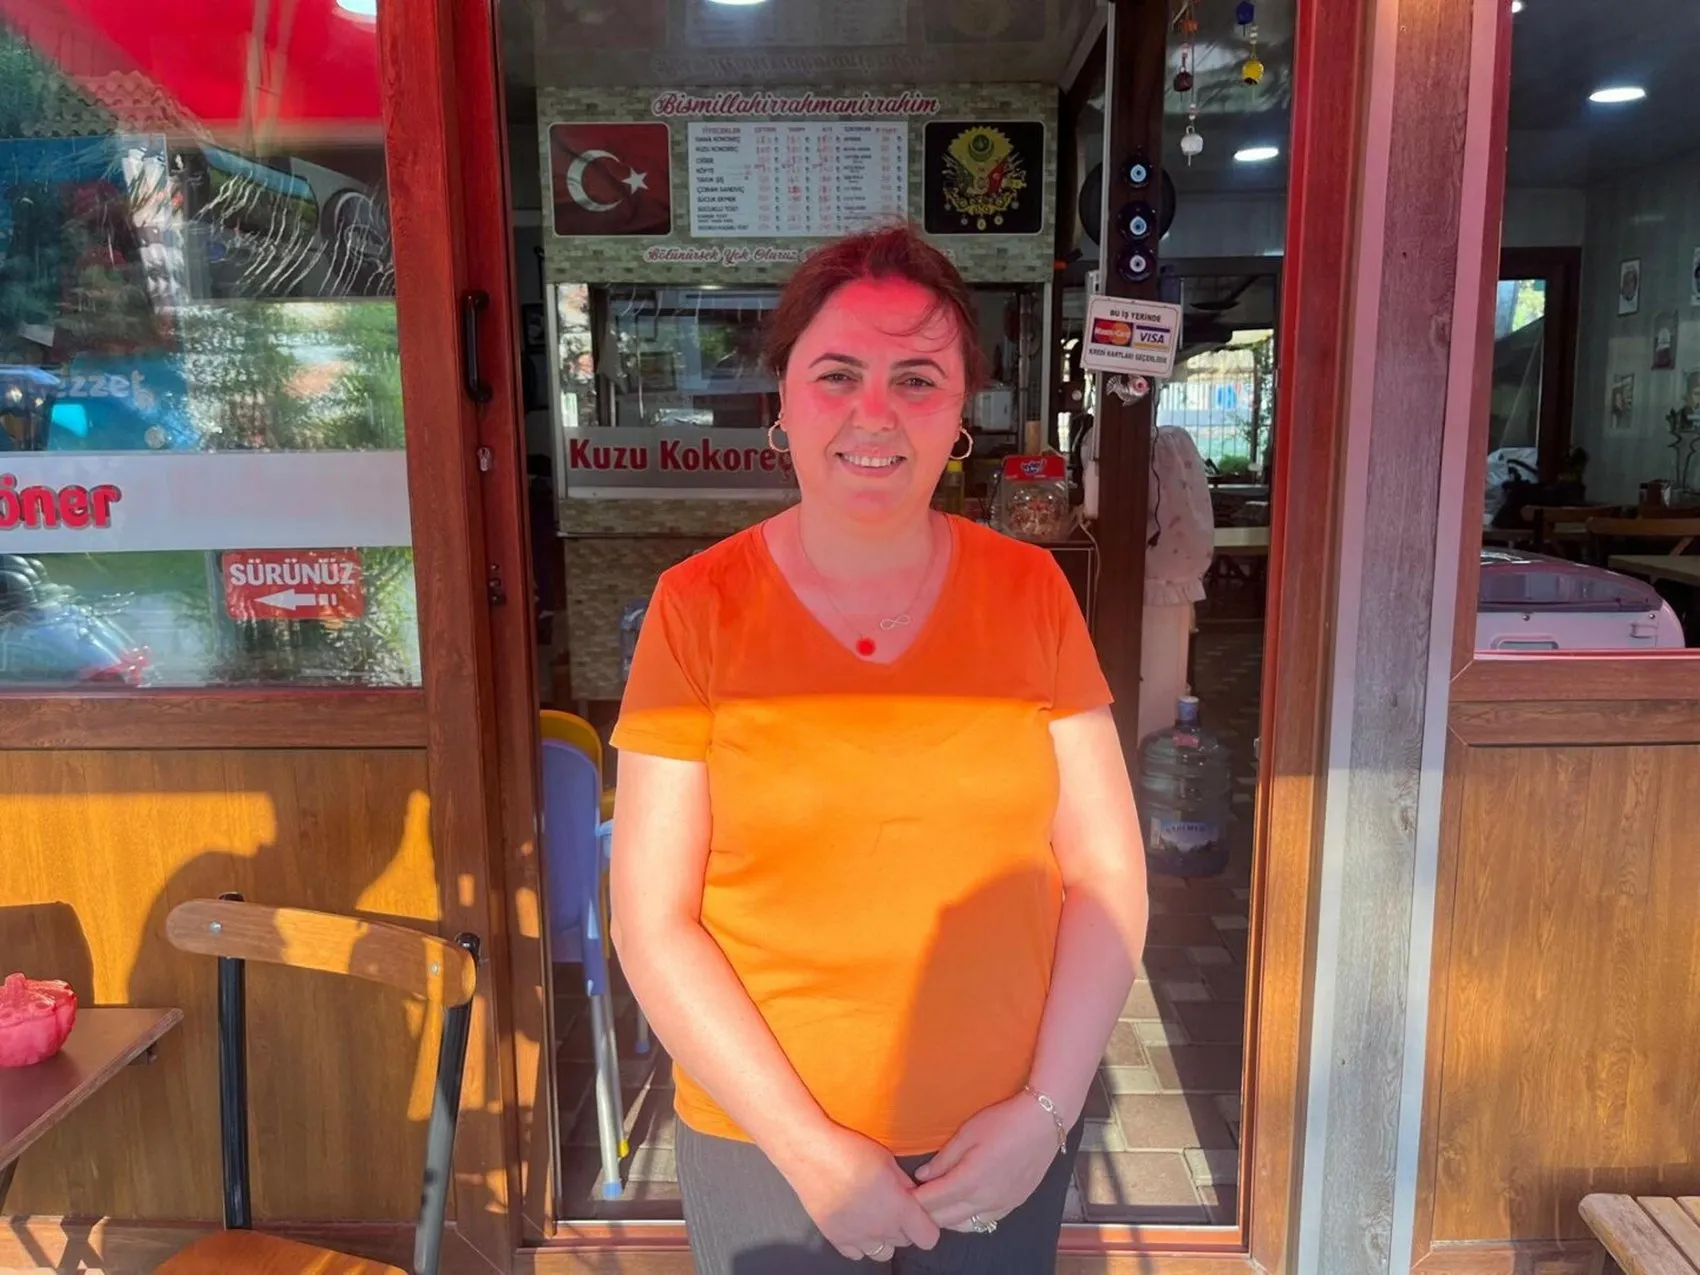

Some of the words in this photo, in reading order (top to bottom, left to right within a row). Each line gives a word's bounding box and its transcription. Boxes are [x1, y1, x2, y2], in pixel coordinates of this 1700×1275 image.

[652, 92, 939, 116] Bismillahirrahmanirrahim
[1140, 332, 1164, 343] VISA
[569, 438, 648, 470] Kuzu
[230, 558, 355, 586] SÜRÜNÜZ
